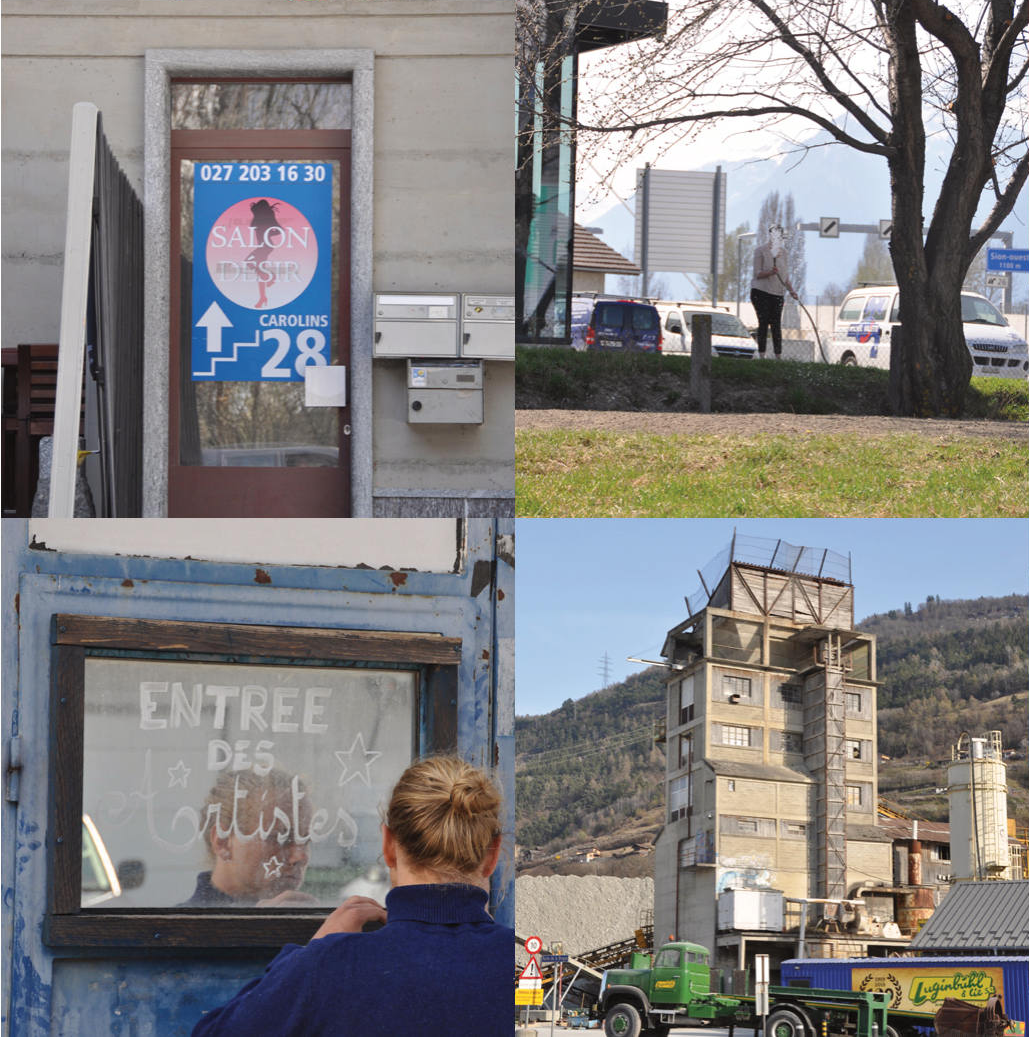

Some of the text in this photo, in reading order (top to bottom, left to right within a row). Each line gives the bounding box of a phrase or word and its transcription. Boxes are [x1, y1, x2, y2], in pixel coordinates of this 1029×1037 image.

[201, 165, 325, 181] 027 203 16 30
[211, 226, 310, 248] SALON
[219, 257, 304, 283] DÉSIR
[260, 314, 328, 327] CAROLINS
[261, 329, 327, 378] 28
[207, 739, 275, 776] DES
[96, 748, 359, 853] Artistes
